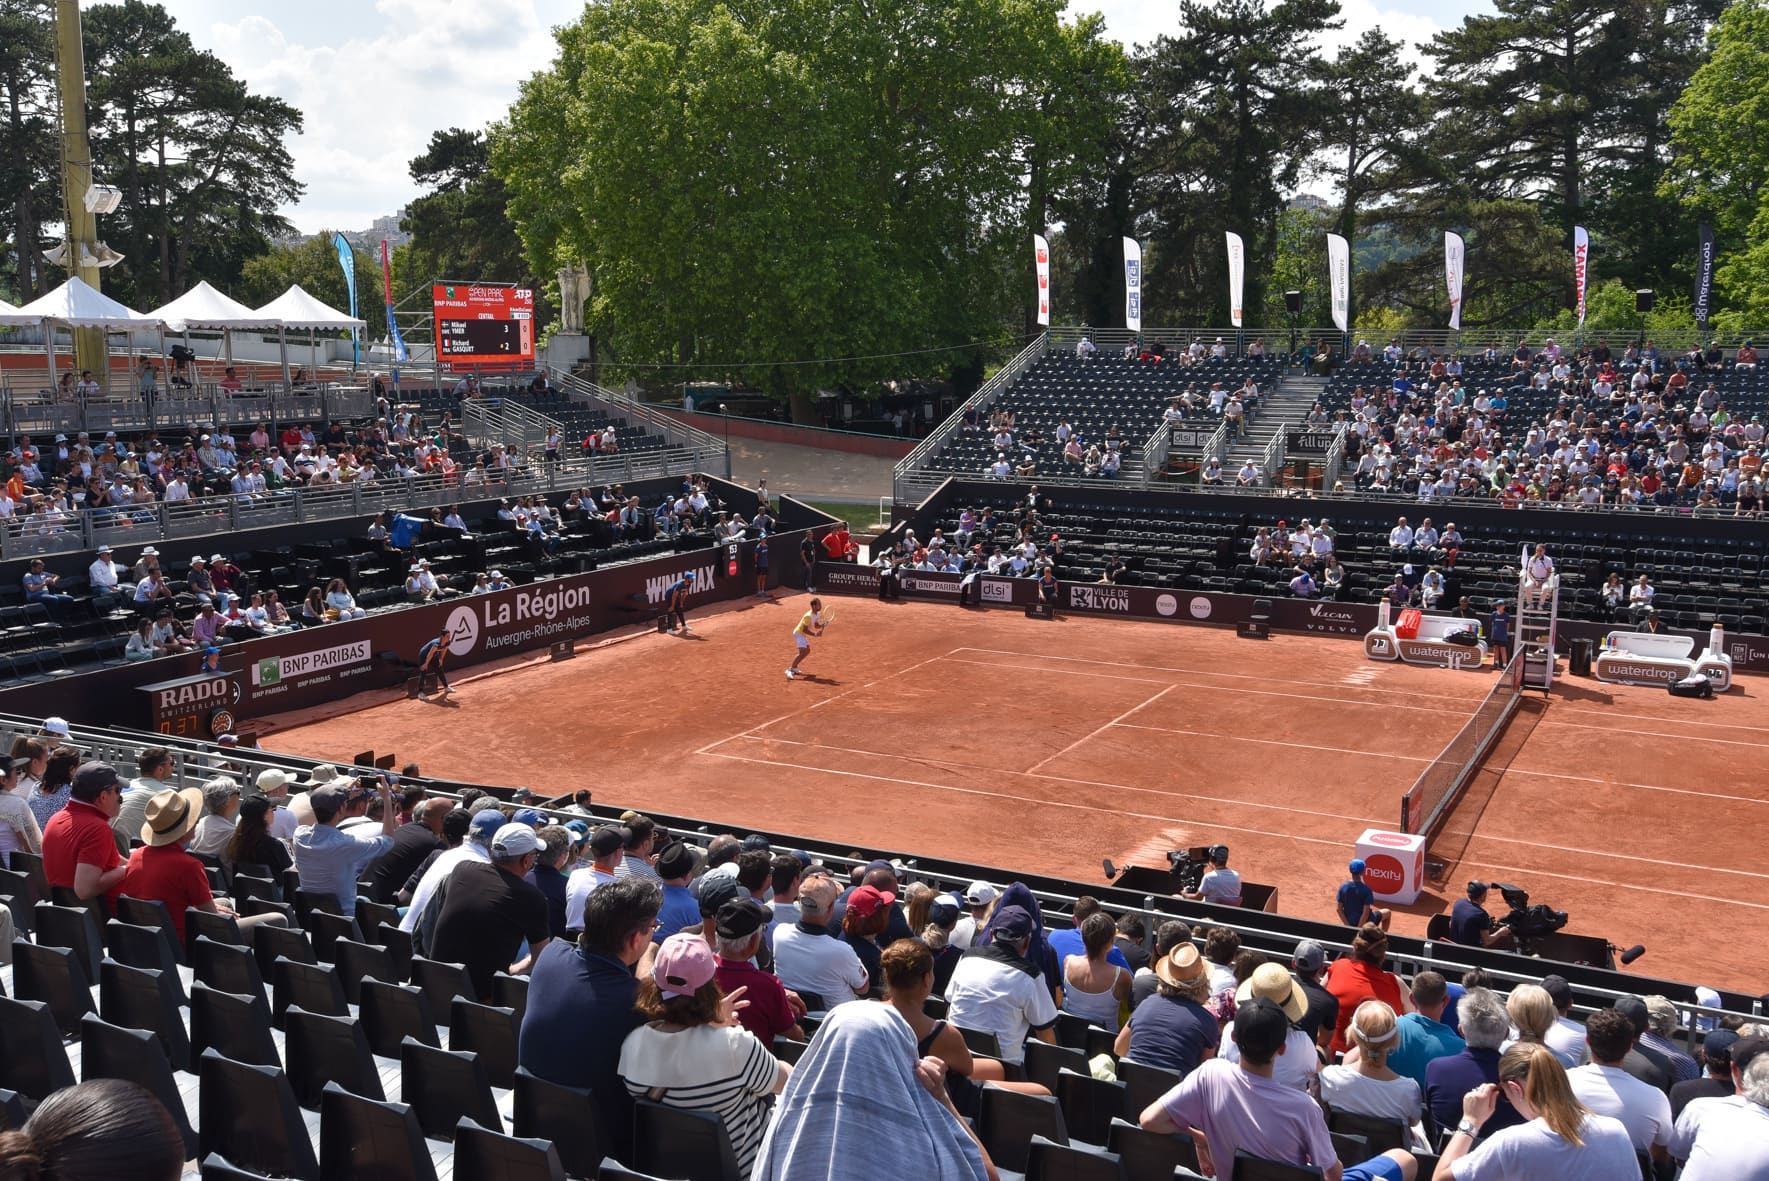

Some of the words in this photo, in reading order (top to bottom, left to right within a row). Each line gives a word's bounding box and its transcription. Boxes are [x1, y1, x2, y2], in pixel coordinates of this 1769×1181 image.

[514, 289, 532, 299] ATP
[504, 325, 509, 333] 3
[504, 343, 510, 351] 2
[1298, 436, 1315, 448] fill
[1317, 440, 1331, 451] up
[829, 573, 855, 581] GROUPE
[934, 583, 960, 591] PARIBA
[983, 584, 1005, 595] dlsi
[1094, 588, 1116, 597] VILLE
[484, 600, 511, 627] La
[516, 584, 590, 620] Région
[1094, 597, 1129, 611] LYON
[485, 615, 590, 649] Auvergne-Rhône-Alpes
[1307, 624, 1357, 633] VOLVO
[283, 656, 309, 674] BNP
[313, 644, 365, 668] PARIBAS
[1410, 647, 1472, 660] waterdrop
[1608, 664, 1677, 680] waterdrop
[297, 680, 309, 688] BNP
[309, 675, 331, 685] PARIBAS
[160, 679, 227, 708] RADO
[252, 691, 265, 699] BNP
[265, 684, 288, 696] PARIBAS
[161, 697, 227, 719] SWITZERLAND
[1365, 867, 1401, 881] nexity
